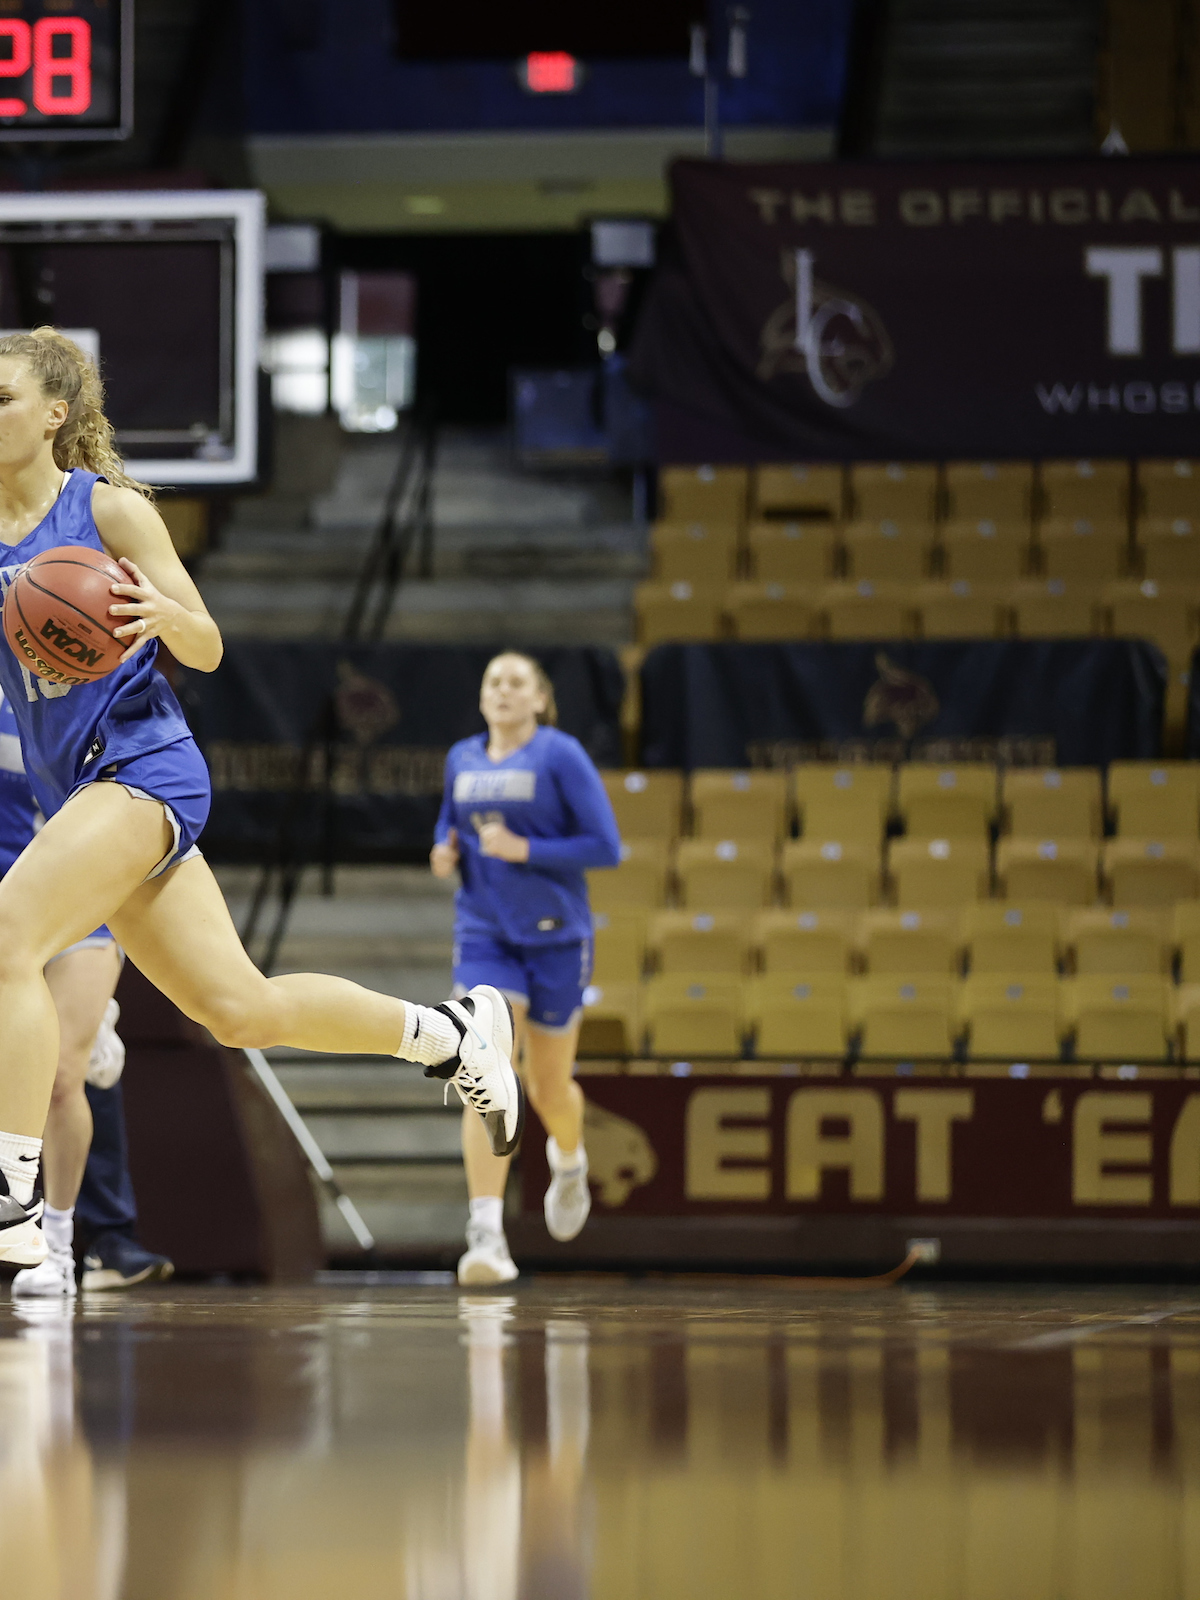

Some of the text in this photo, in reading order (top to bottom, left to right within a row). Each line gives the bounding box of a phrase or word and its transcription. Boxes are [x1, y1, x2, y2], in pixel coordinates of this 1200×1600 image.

[748, 186, 1200, 227] THE OFFICIAL
[40, 618, 105, 668] NCAA
[684, 1085, 975, 1203] EAT
